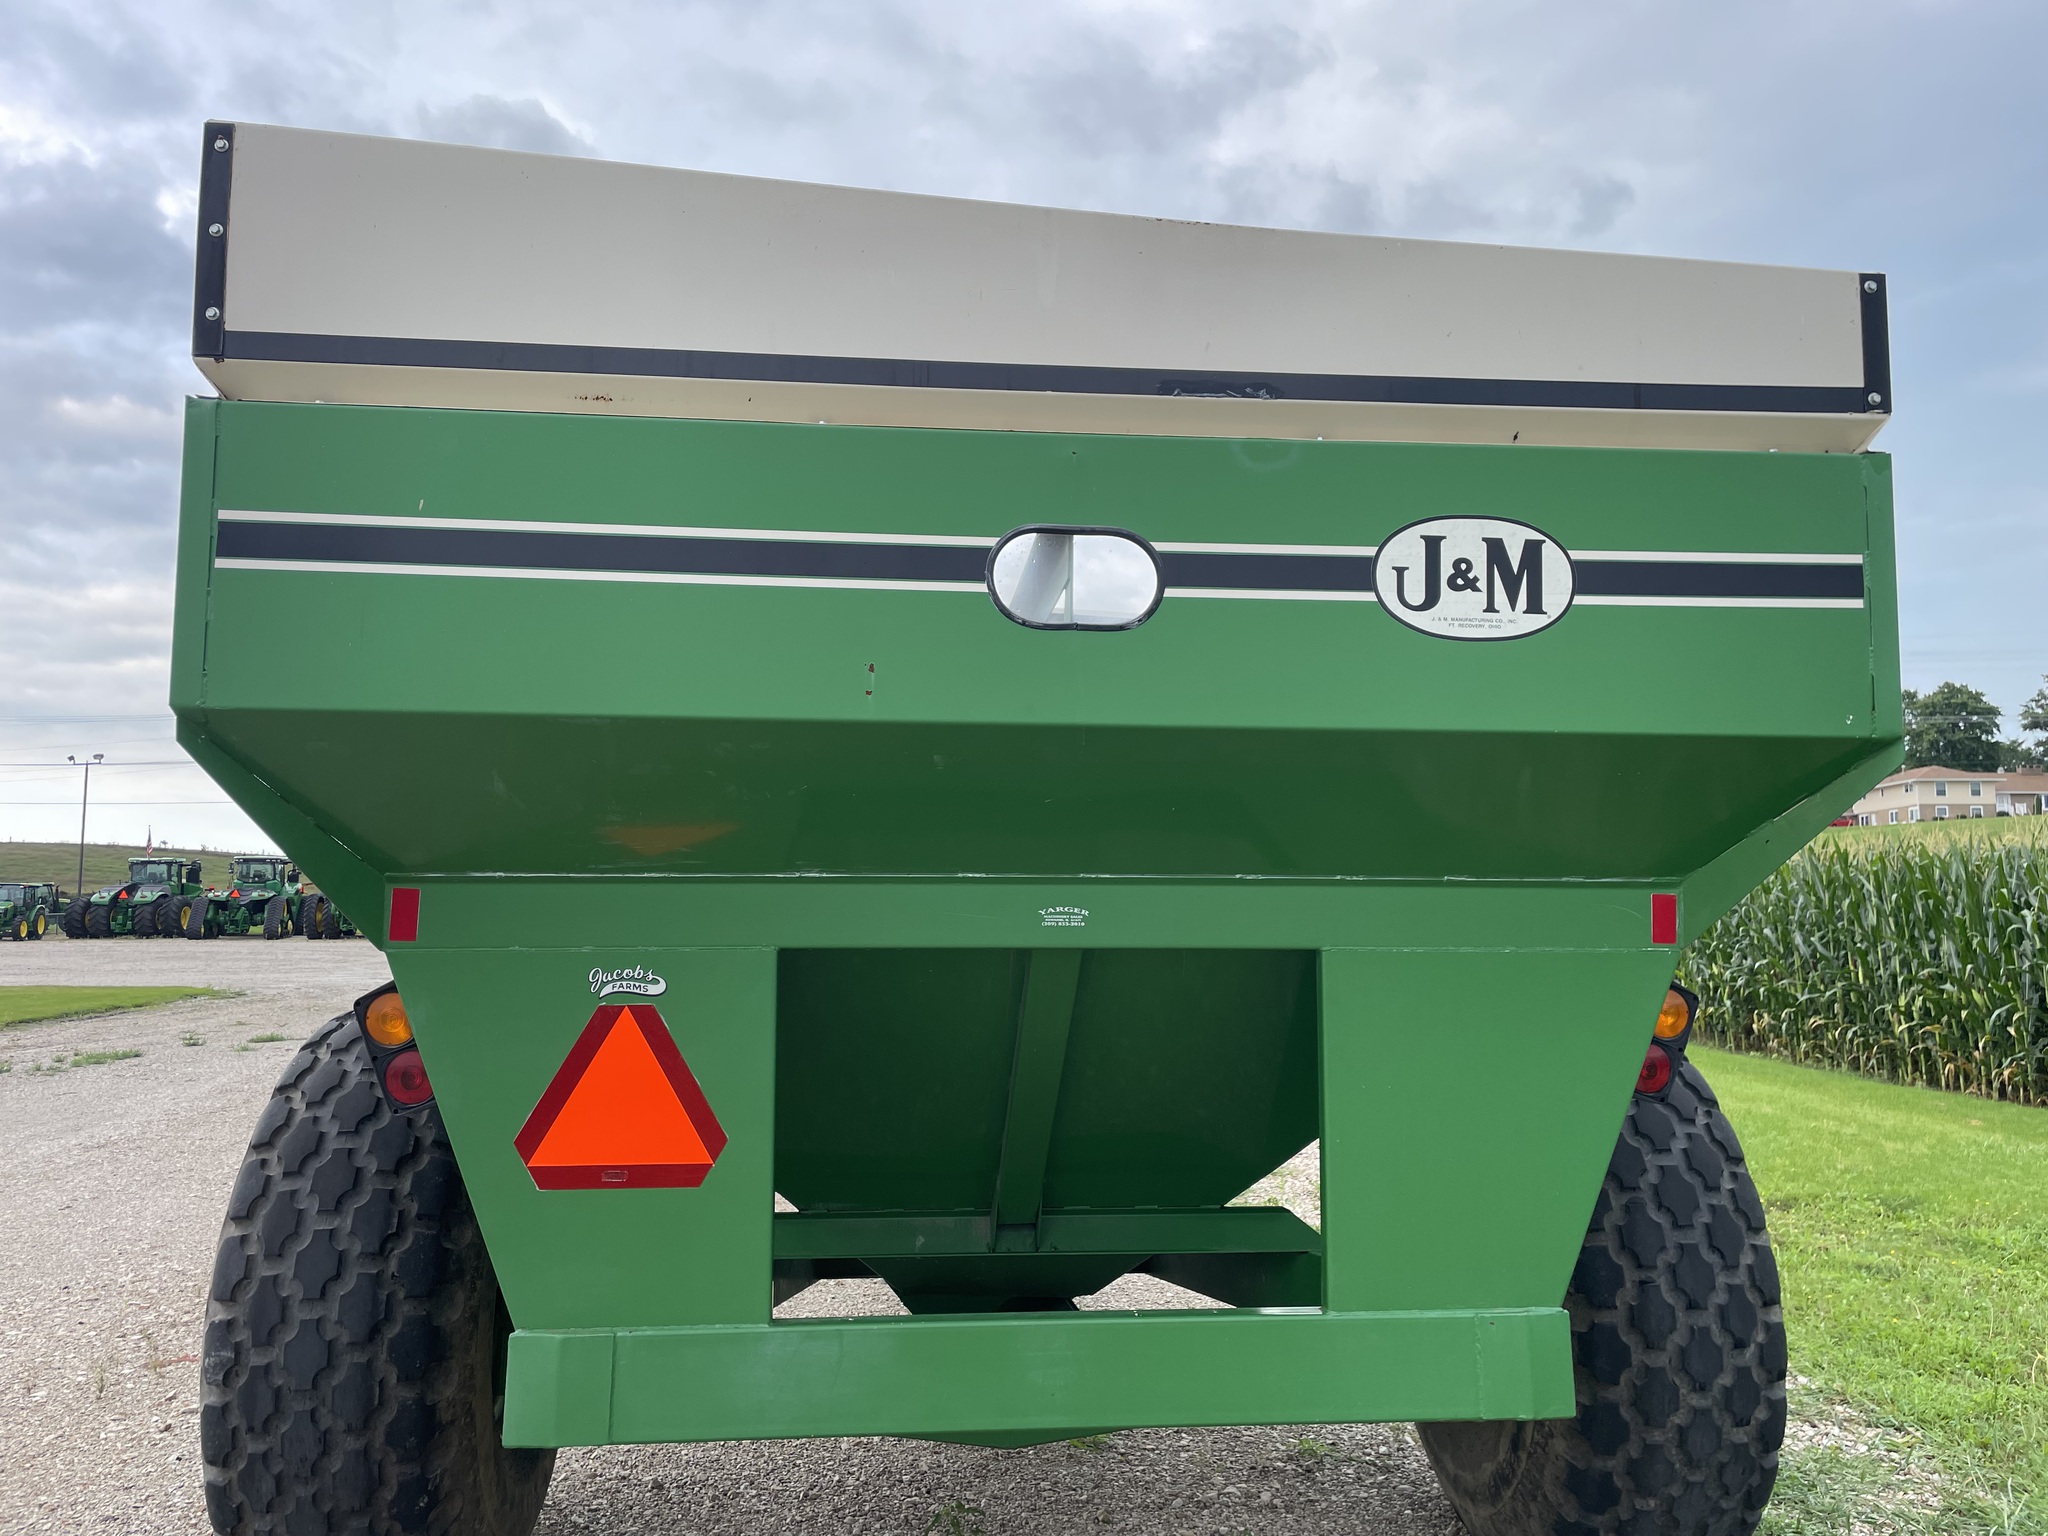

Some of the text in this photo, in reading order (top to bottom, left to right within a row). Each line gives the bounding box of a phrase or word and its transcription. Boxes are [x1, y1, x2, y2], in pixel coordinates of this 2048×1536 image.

[1392, 534, 1548, 615] J&M
[1038, 906, 1089, 917] YARGER
[612, 982, 649, 993] FARMS
